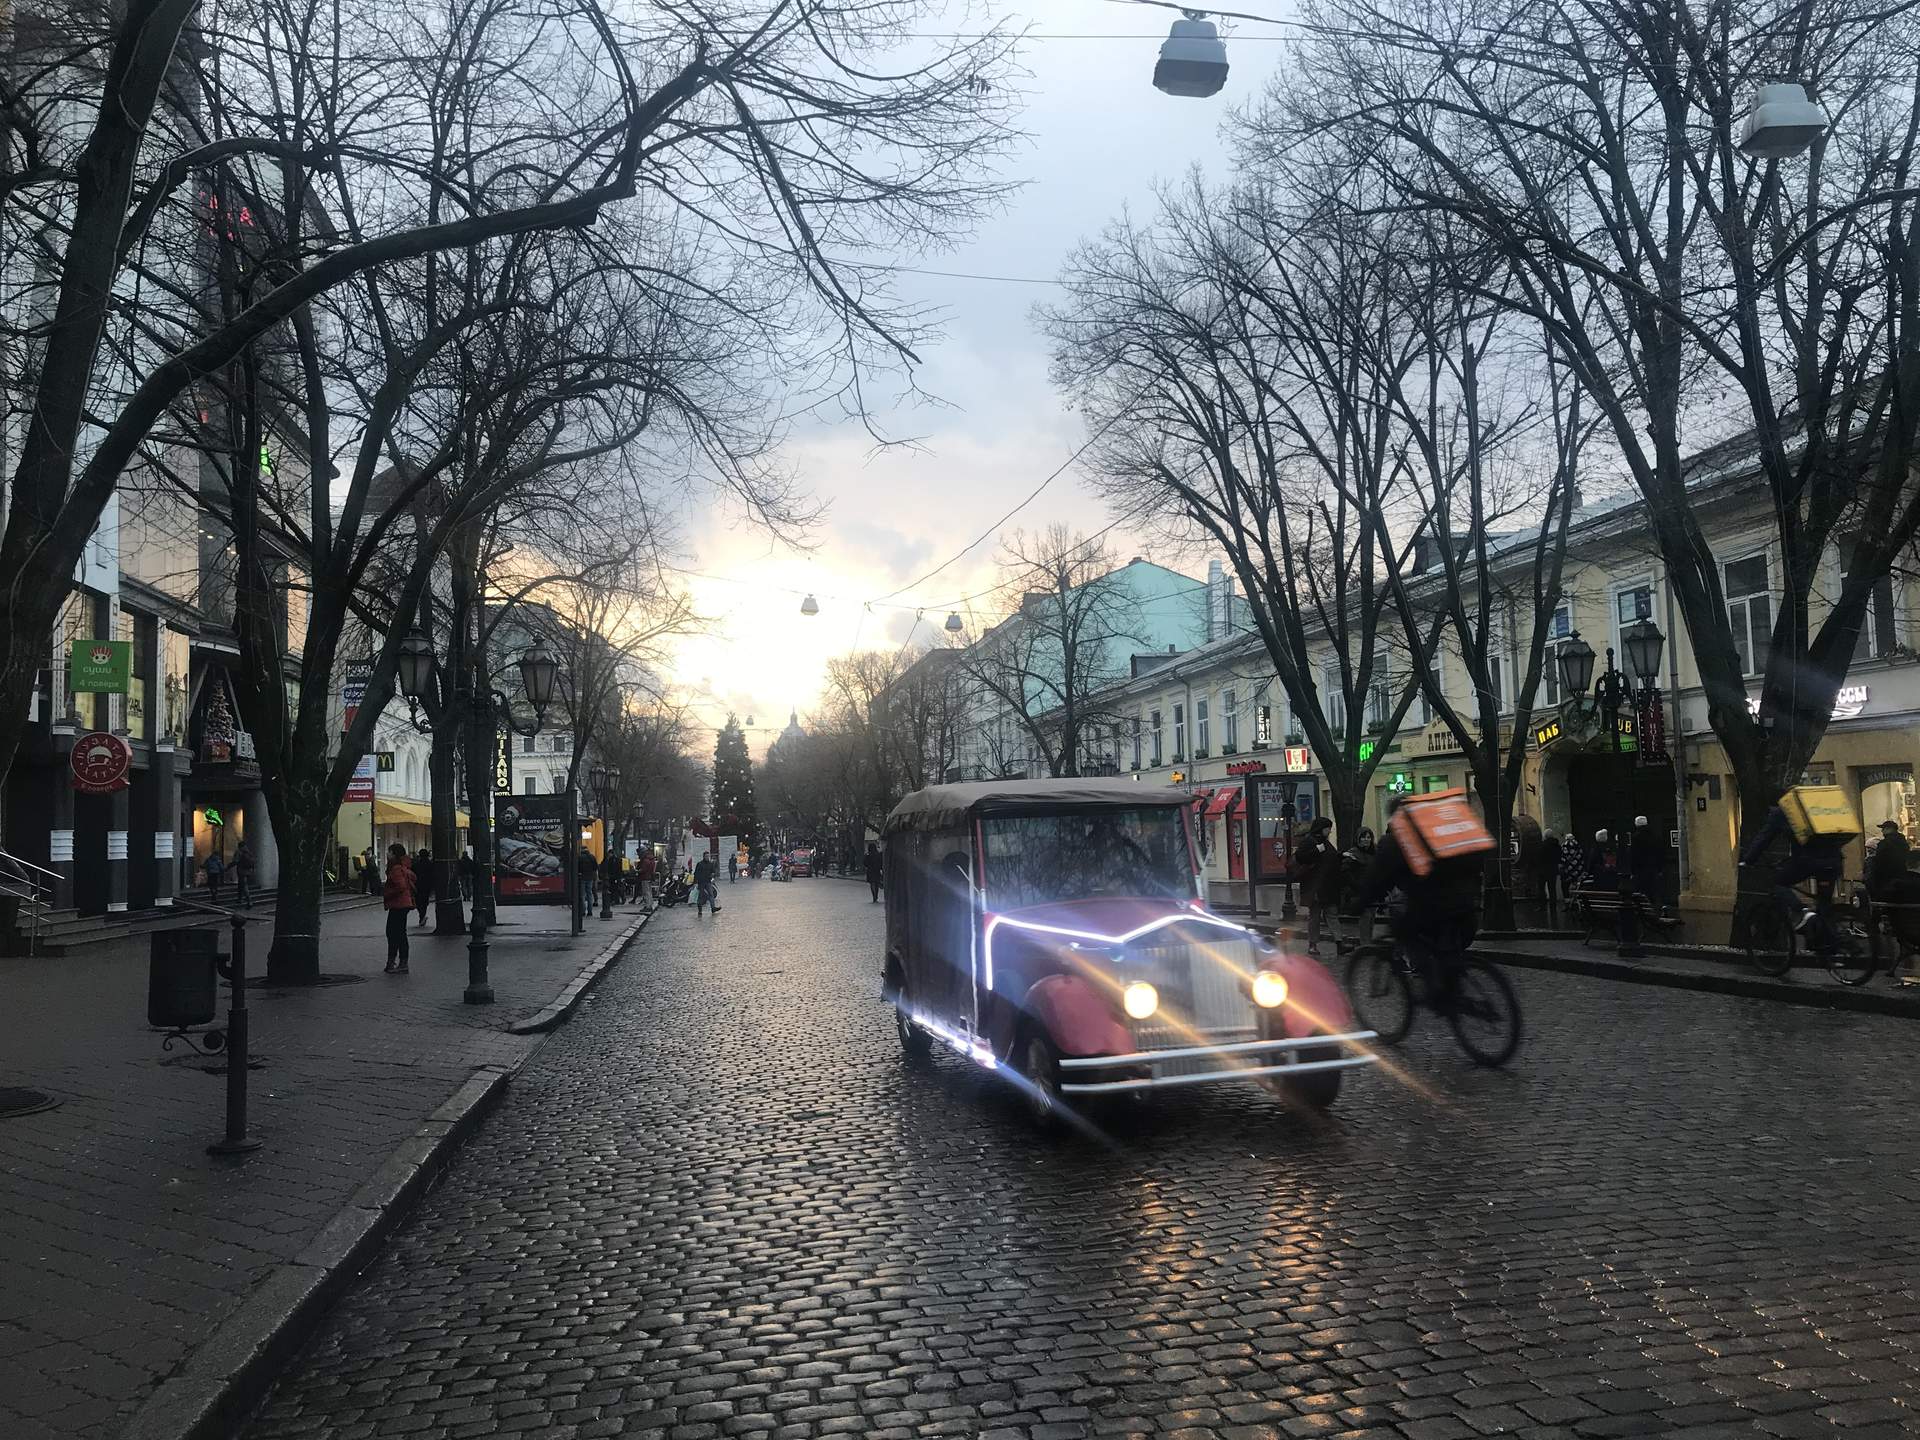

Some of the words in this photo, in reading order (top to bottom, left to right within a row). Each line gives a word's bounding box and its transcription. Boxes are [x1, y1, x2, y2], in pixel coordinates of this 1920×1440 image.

[1428, 731, 1462, 752] АПТЕК
[1538, 723, 1559, 744] ПАБ
[496, 729, 508, 787] MILANO
